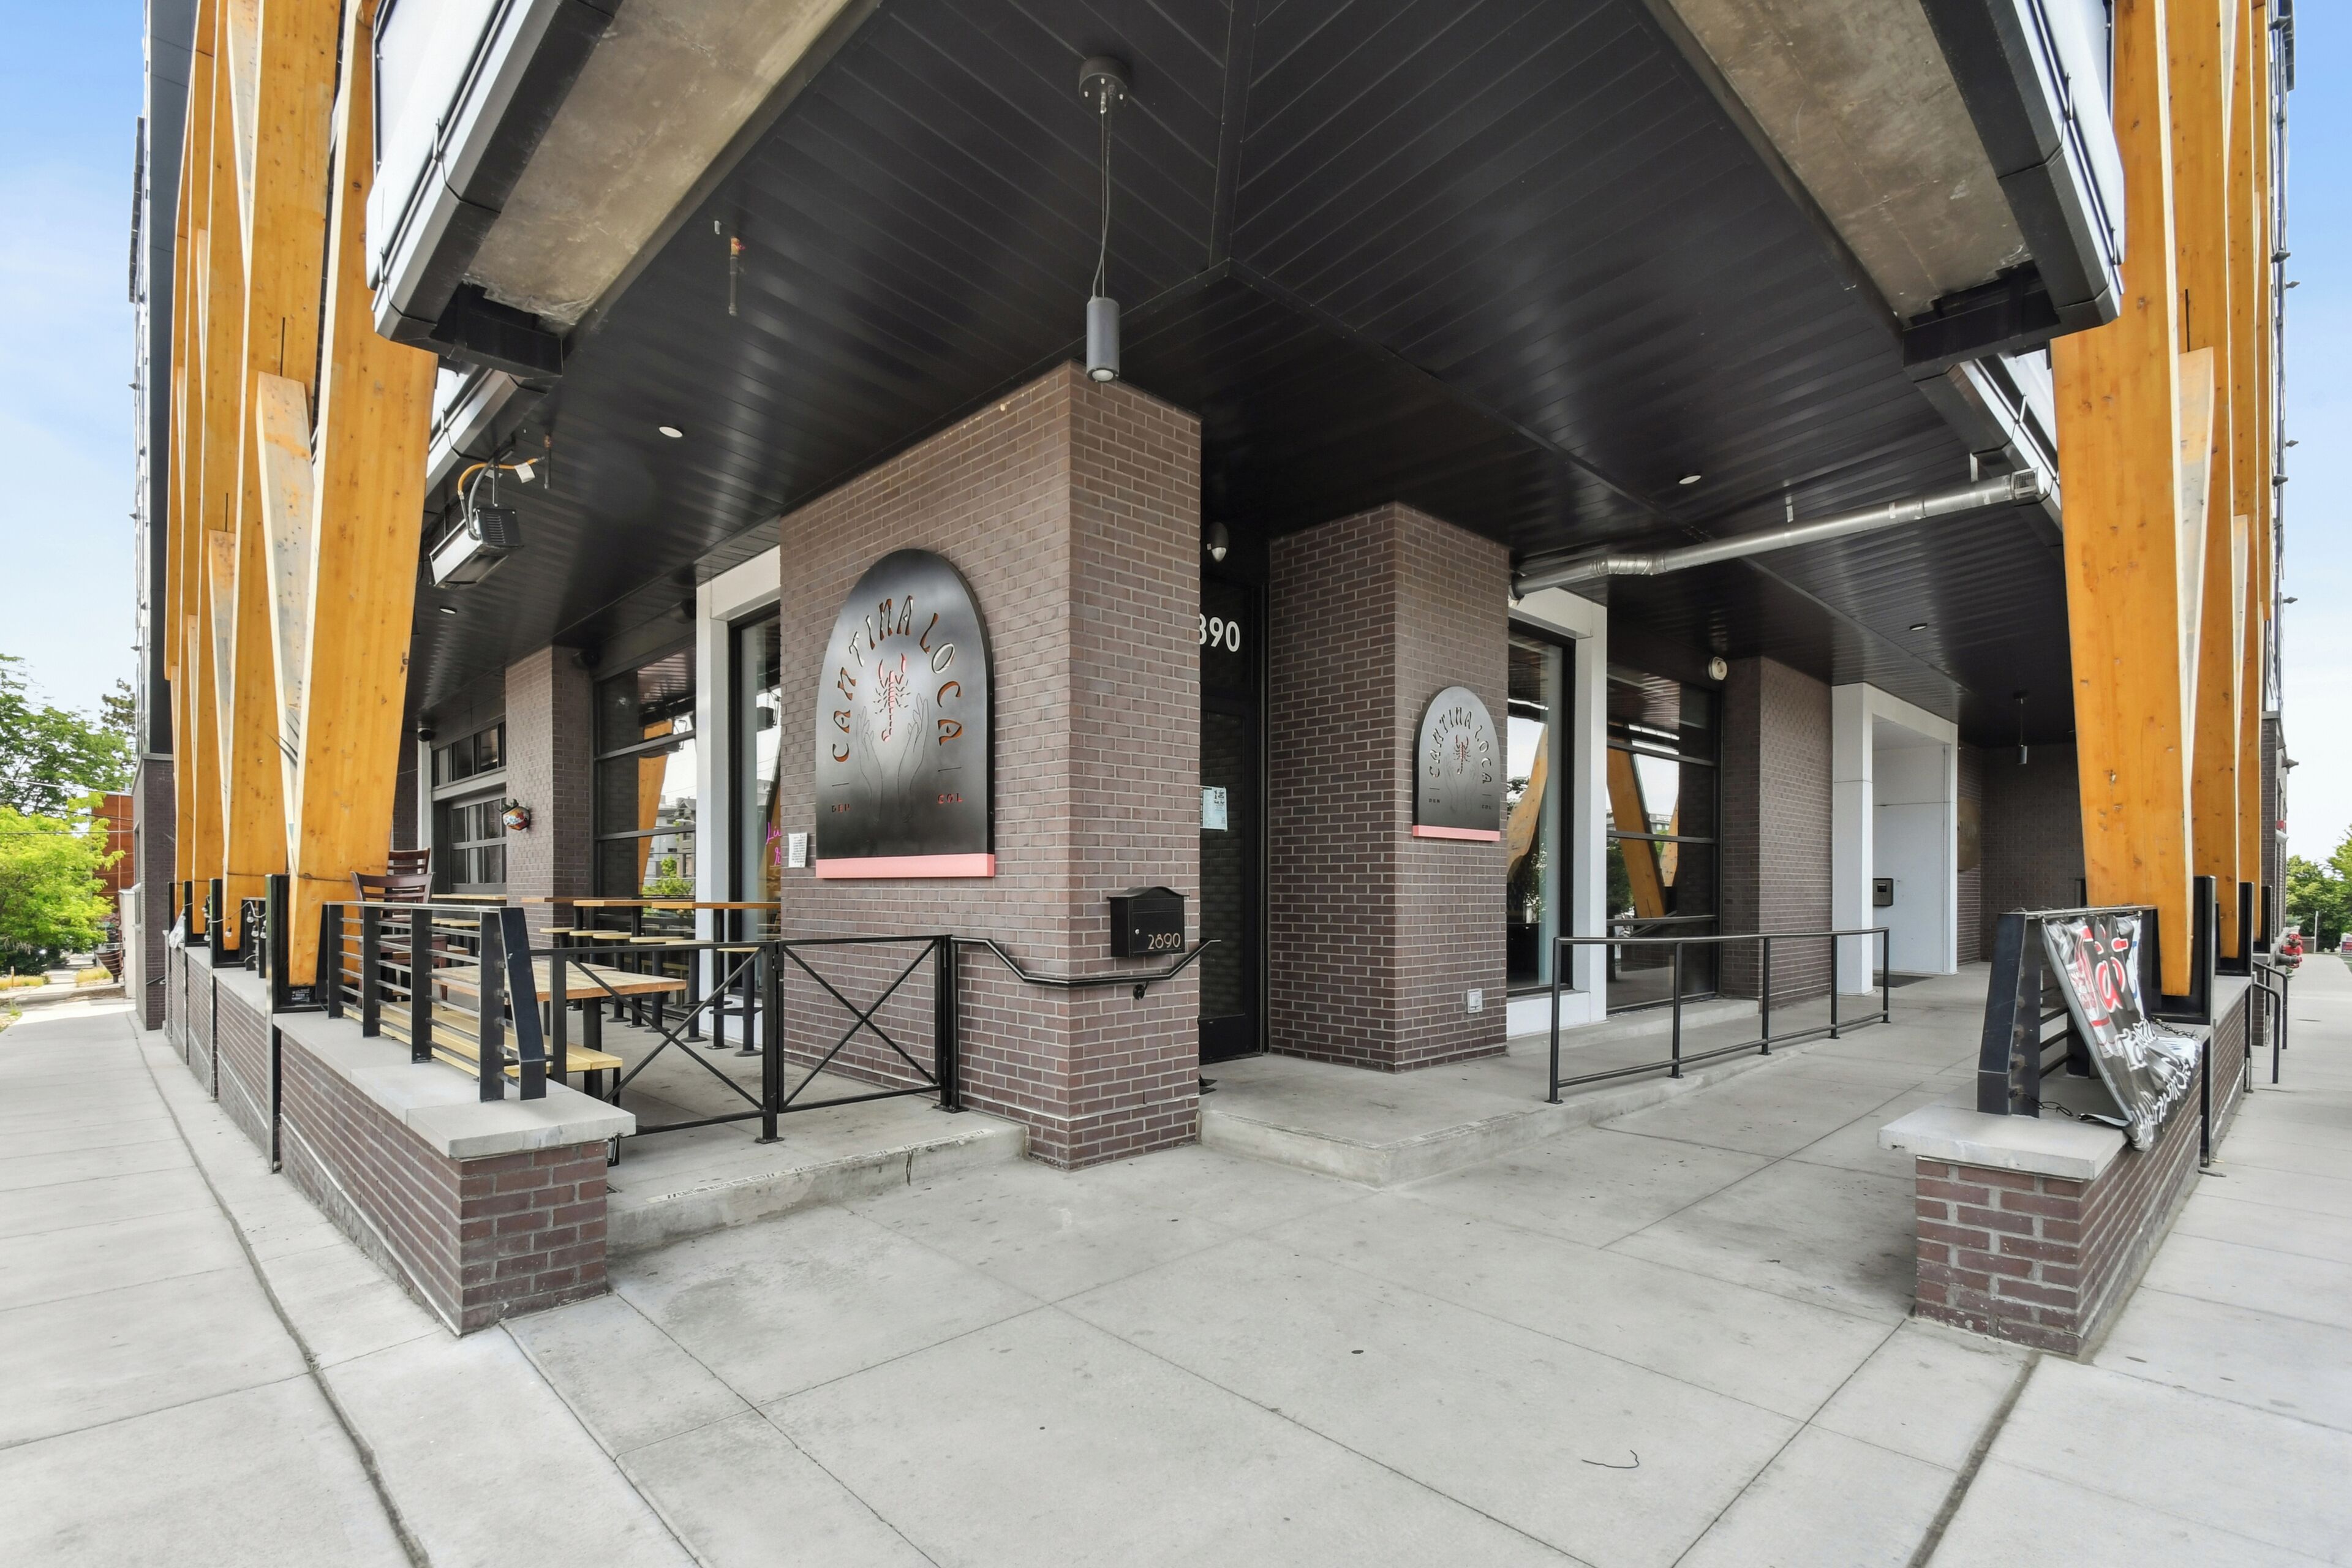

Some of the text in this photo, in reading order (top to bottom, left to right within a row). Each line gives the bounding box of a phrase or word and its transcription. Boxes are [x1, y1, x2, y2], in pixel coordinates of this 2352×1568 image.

[832, 595, 962, 763] CANTINA LOCA
[1429, 707, 1492, 784] CANTINA LOCA
[937, 793, 963, 804] COL
[1148, 933, 1181, 949] 2890
